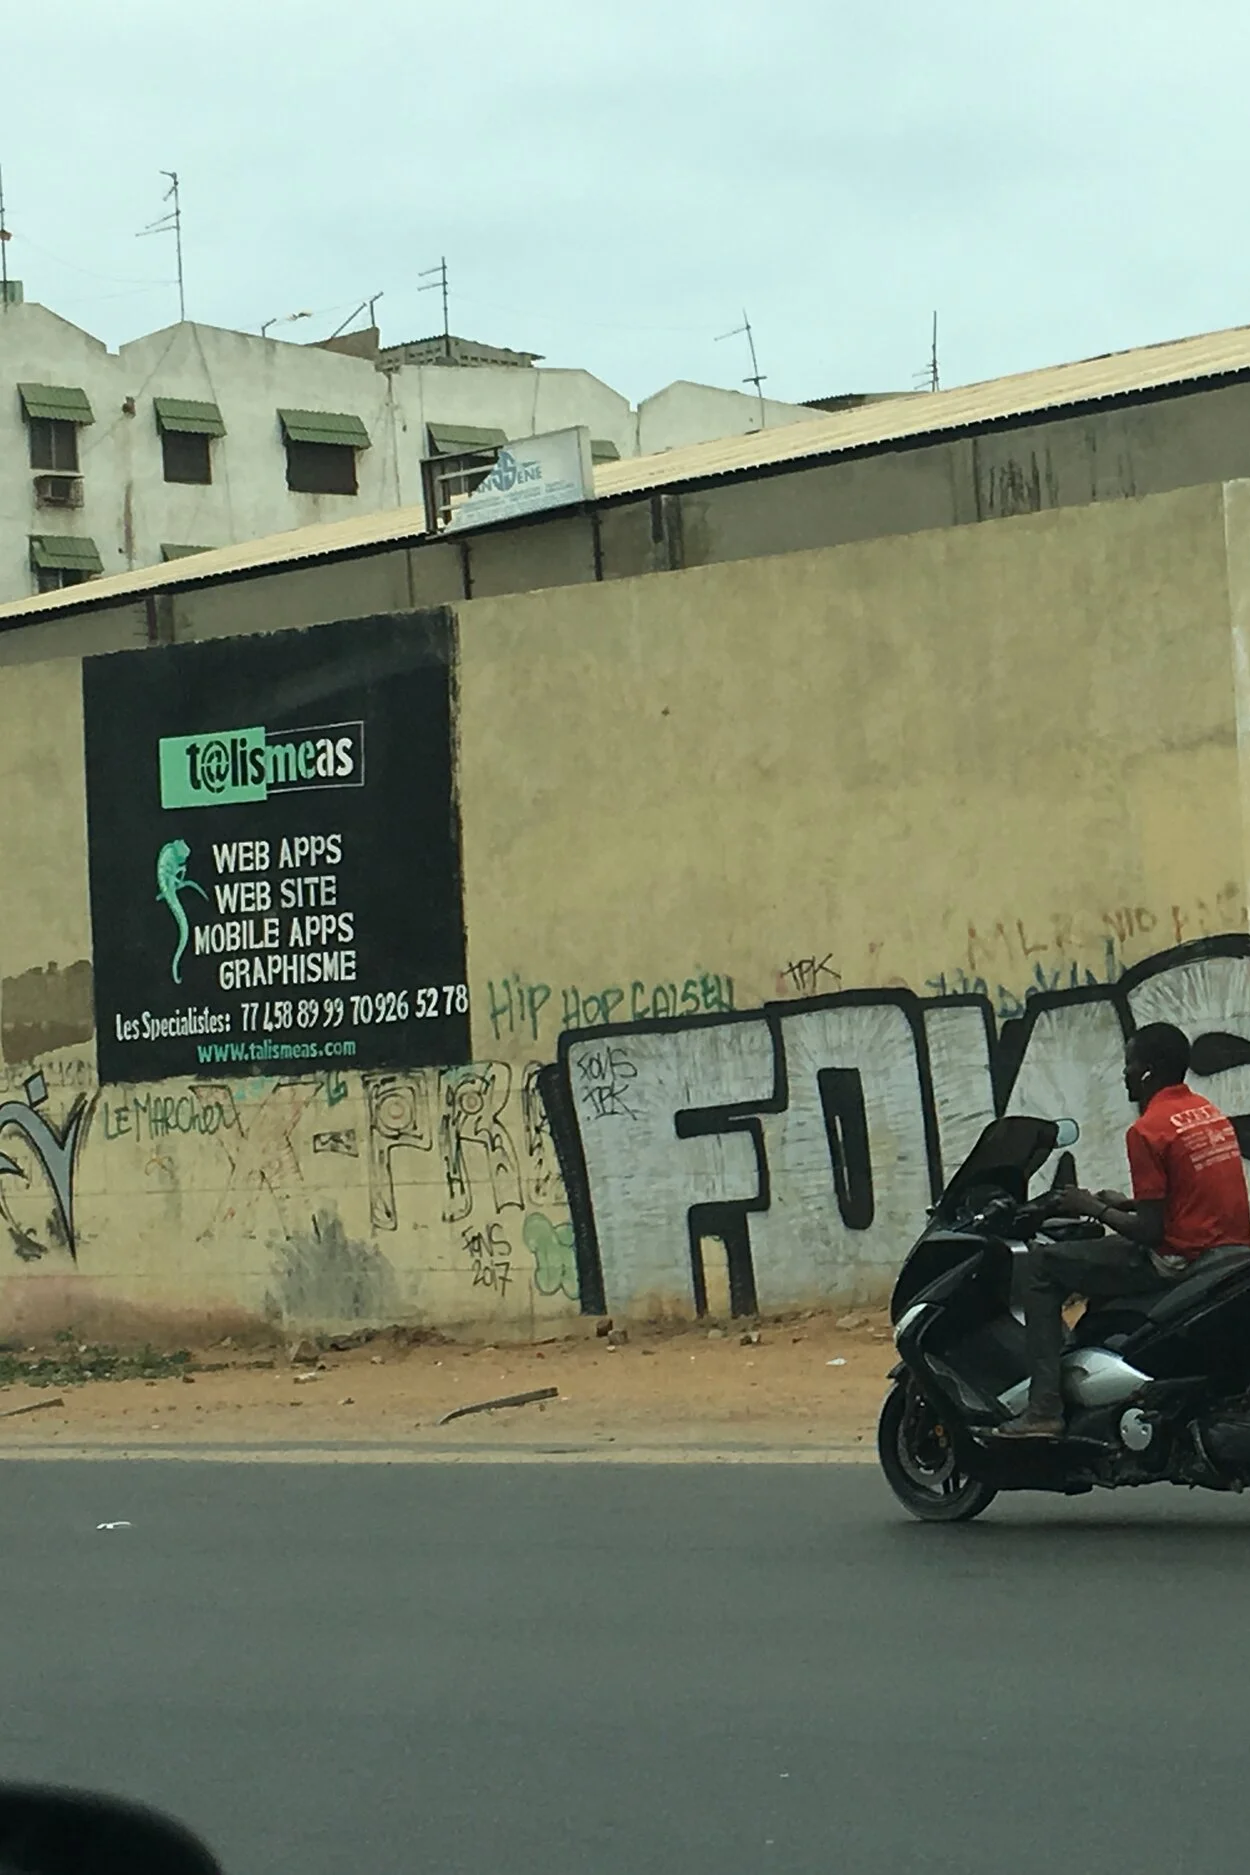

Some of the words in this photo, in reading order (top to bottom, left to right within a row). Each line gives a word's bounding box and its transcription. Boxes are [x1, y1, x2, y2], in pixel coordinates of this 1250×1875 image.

[185, 735, 354, 795] t@lismeas
[211, 840, 271, 874] WEB
[278, 833, 342, 869] APPS
[214, 880, 272, 915] WEB
[280, 874, 337, 909] SITE
[193, 917, 280, 956] MOBILE
[288, 911, 355, 948] APPS
[218, 949, 357, 991] GRAPHISME
[141, 1005, 231, 1042] Specialistes:
[197, 1038, 357, 1064] www.talismeas.com
[471, 1258, 515, 1298] 2017
